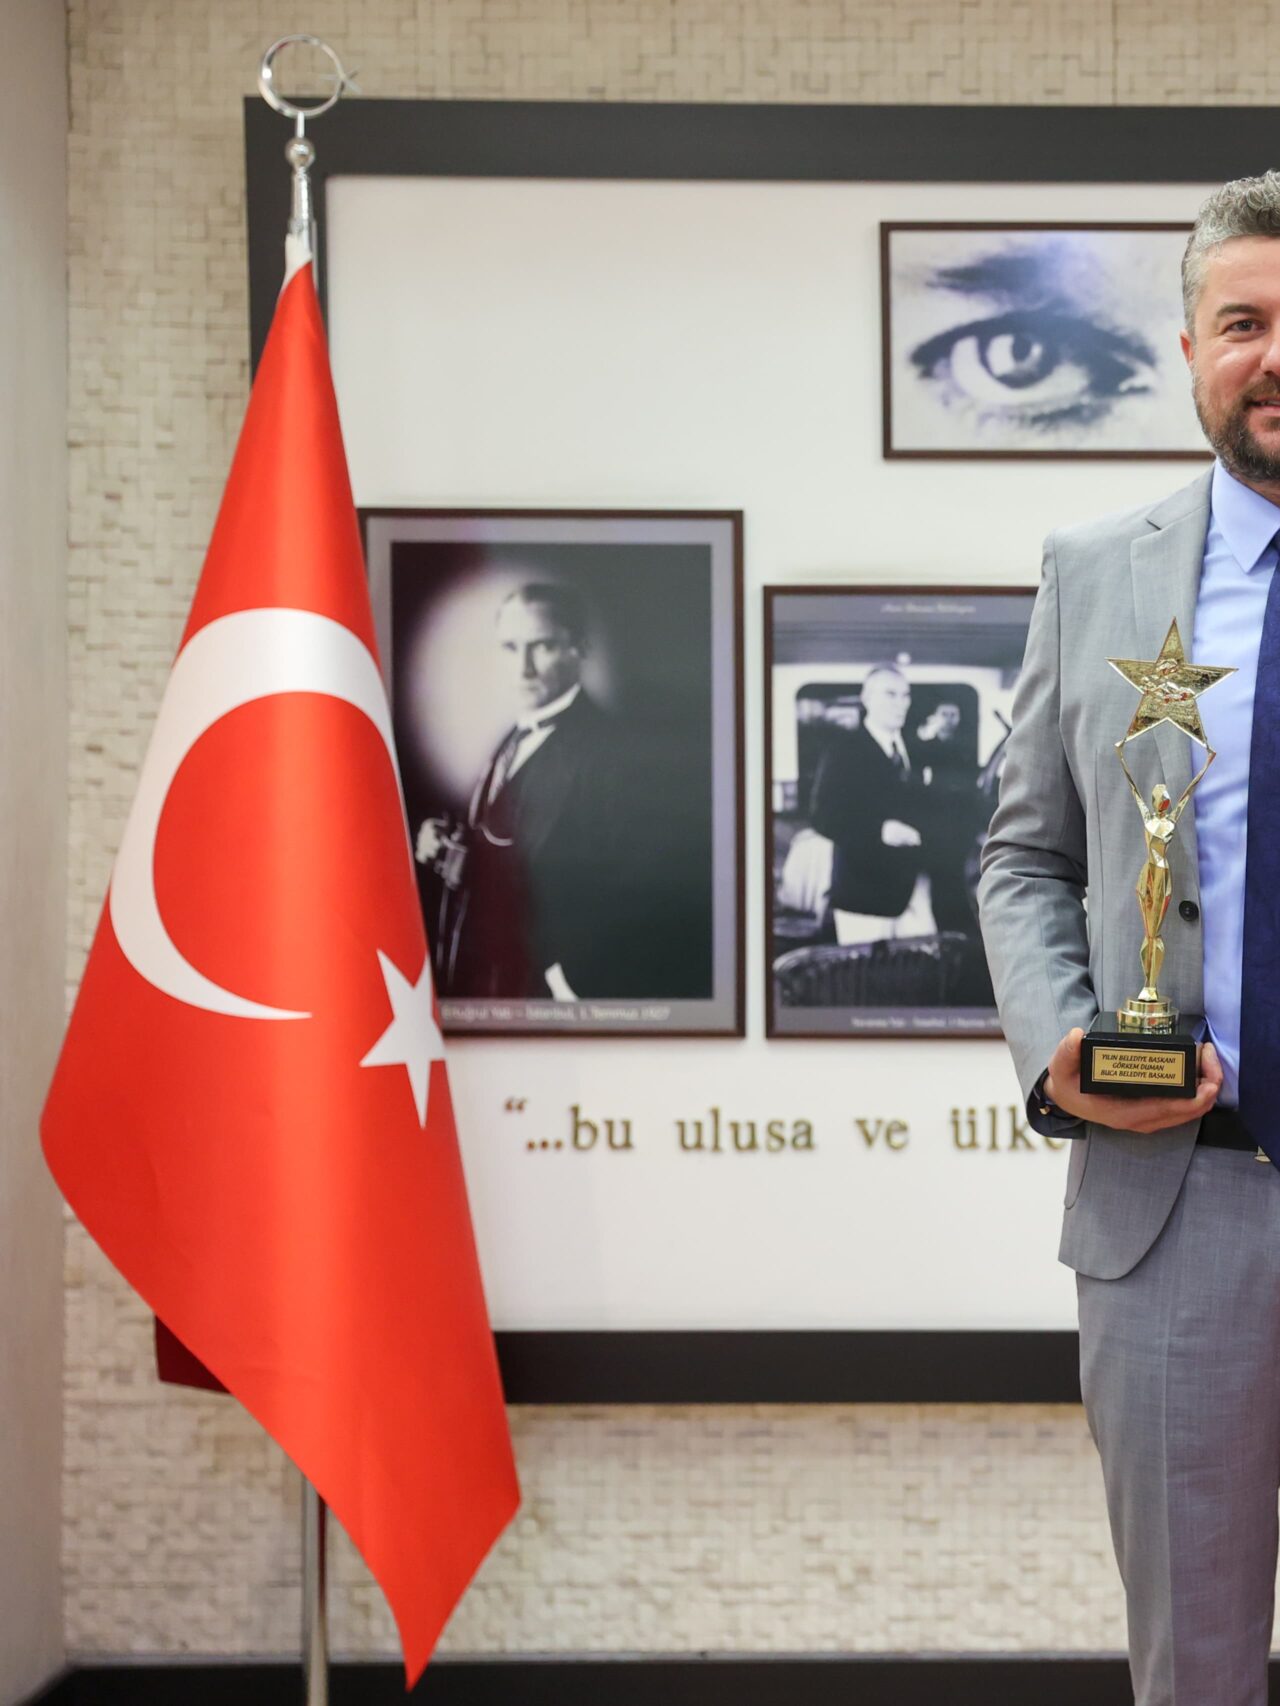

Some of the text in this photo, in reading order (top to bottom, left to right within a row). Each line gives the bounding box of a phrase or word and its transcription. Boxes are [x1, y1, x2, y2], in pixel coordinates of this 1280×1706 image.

[1100, 1069, 1118, 1077] BUCA
[674, 1106, 815, 1152] ulusa
[856, 1116, 909, 1150] ve
